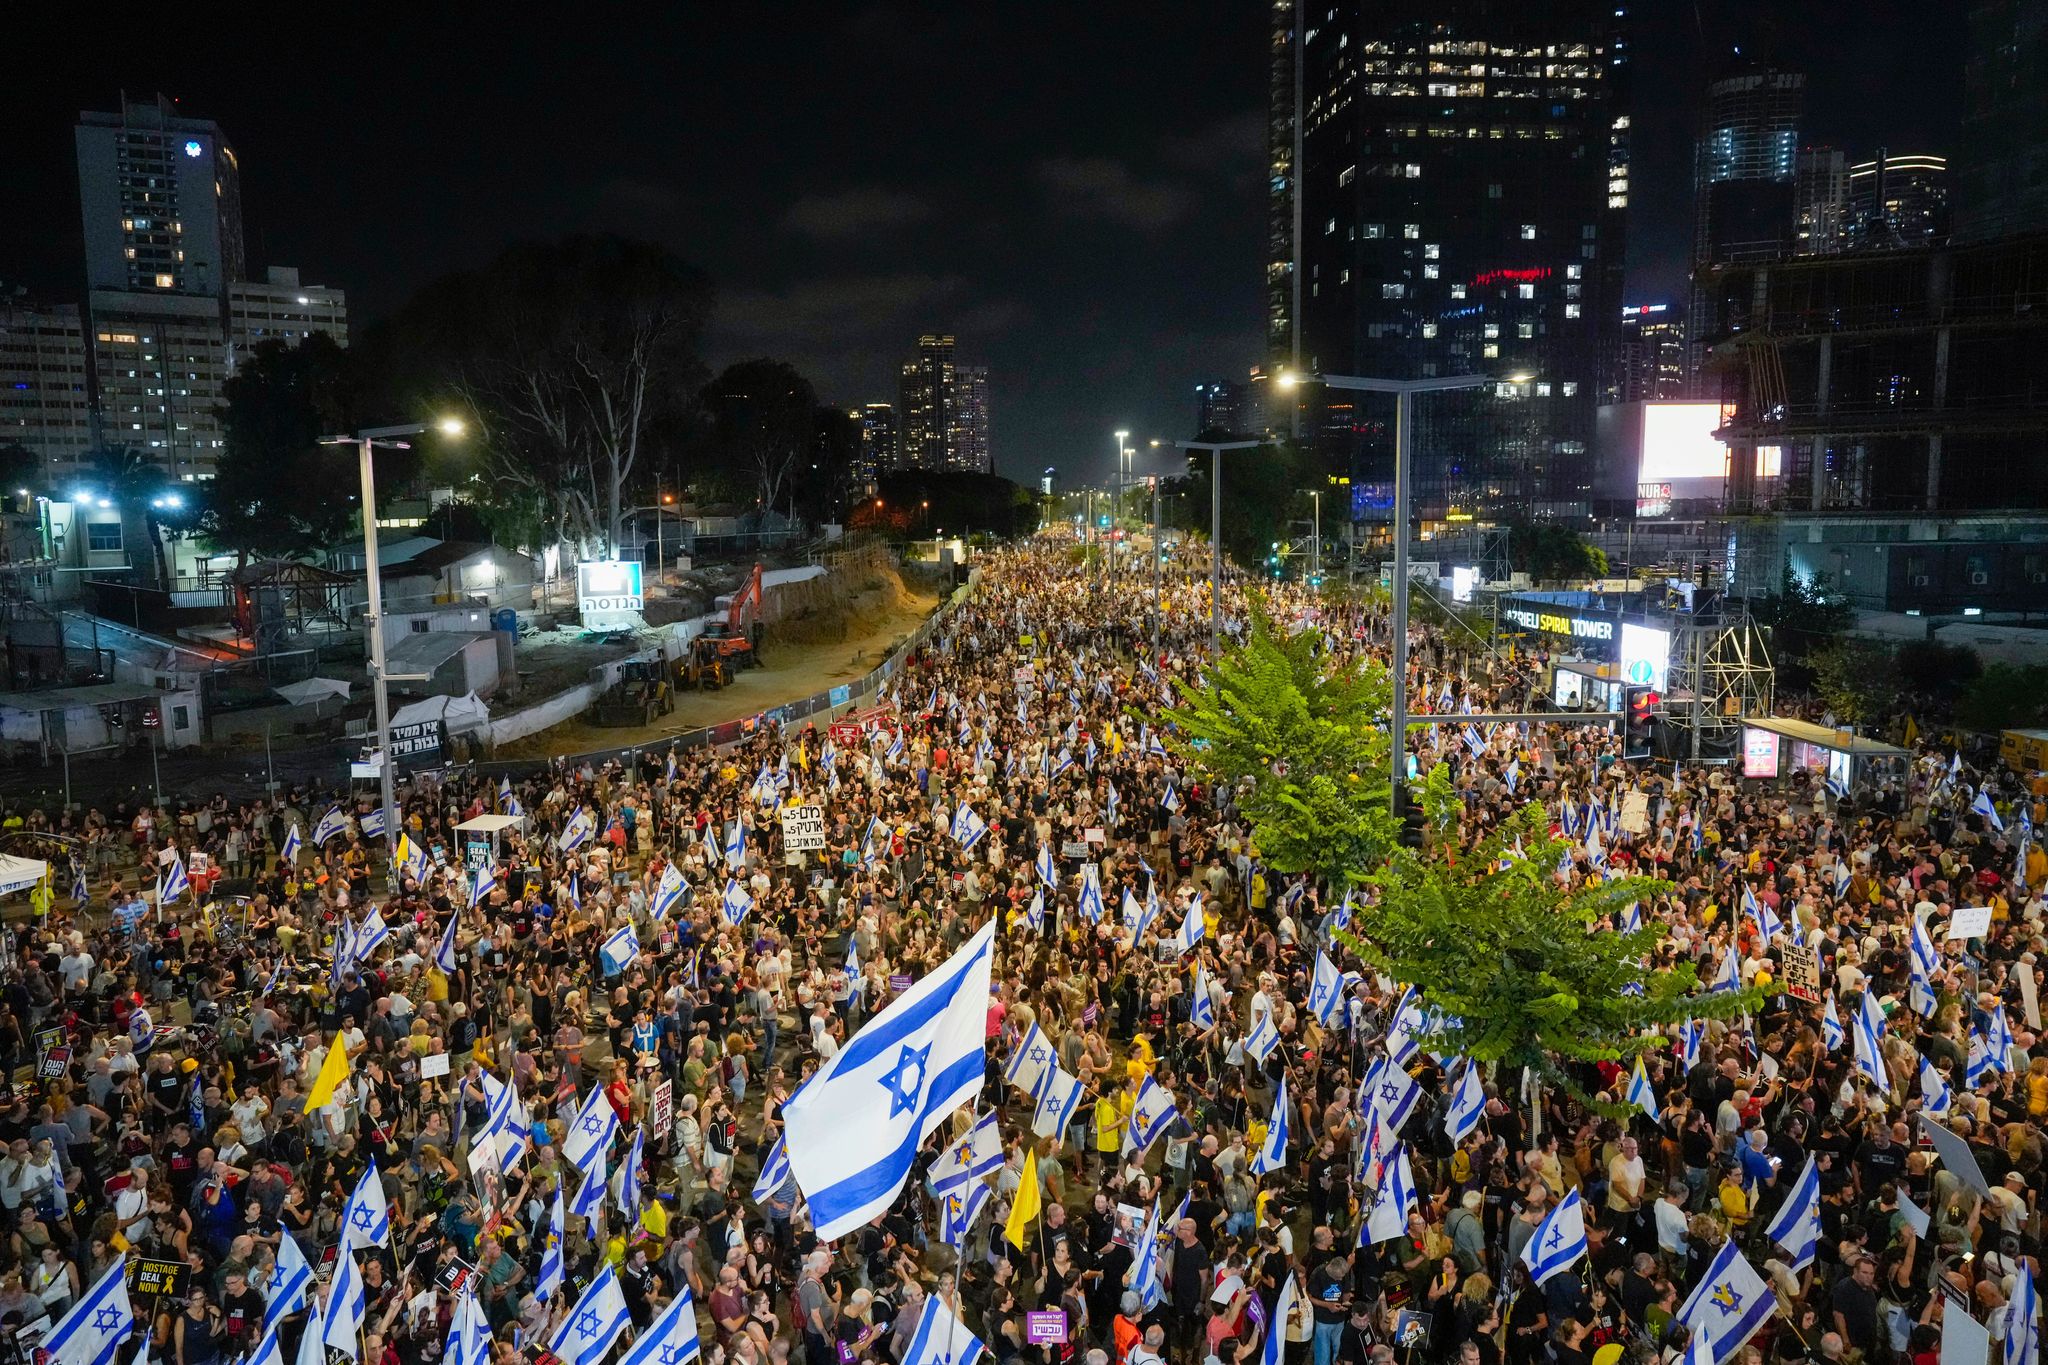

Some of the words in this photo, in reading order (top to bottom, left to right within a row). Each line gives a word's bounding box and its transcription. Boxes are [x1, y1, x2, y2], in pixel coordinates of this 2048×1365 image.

[585, 597, 641, 611] הנדסה
[1507, 609, 1540, 630] AZRIELI
[1540, 614, 1572, 636] SPIRAL
[1571, 618, 1613, 640] TOWER
[422, 720, 438, 736] אין
[414, 734, 439, 751] גבוה
[1784, 943, 1812, 958] HELP
[1783, 952, 1815, 969] THEM
[1783, 960, 1807, 975] GET
[1786, 977, 1799, 986] OF
[1789, 970, 1808, 983] OUT
[46, 1060, 65, 1070] העם
[142, 1262, 180, 1275] HOSTAGE
[140, 1271, 161, 1283] DEAL
[138, 1282, 161, 1294] NOW
[1034, 1325, 1061, 1334] עכשיו
